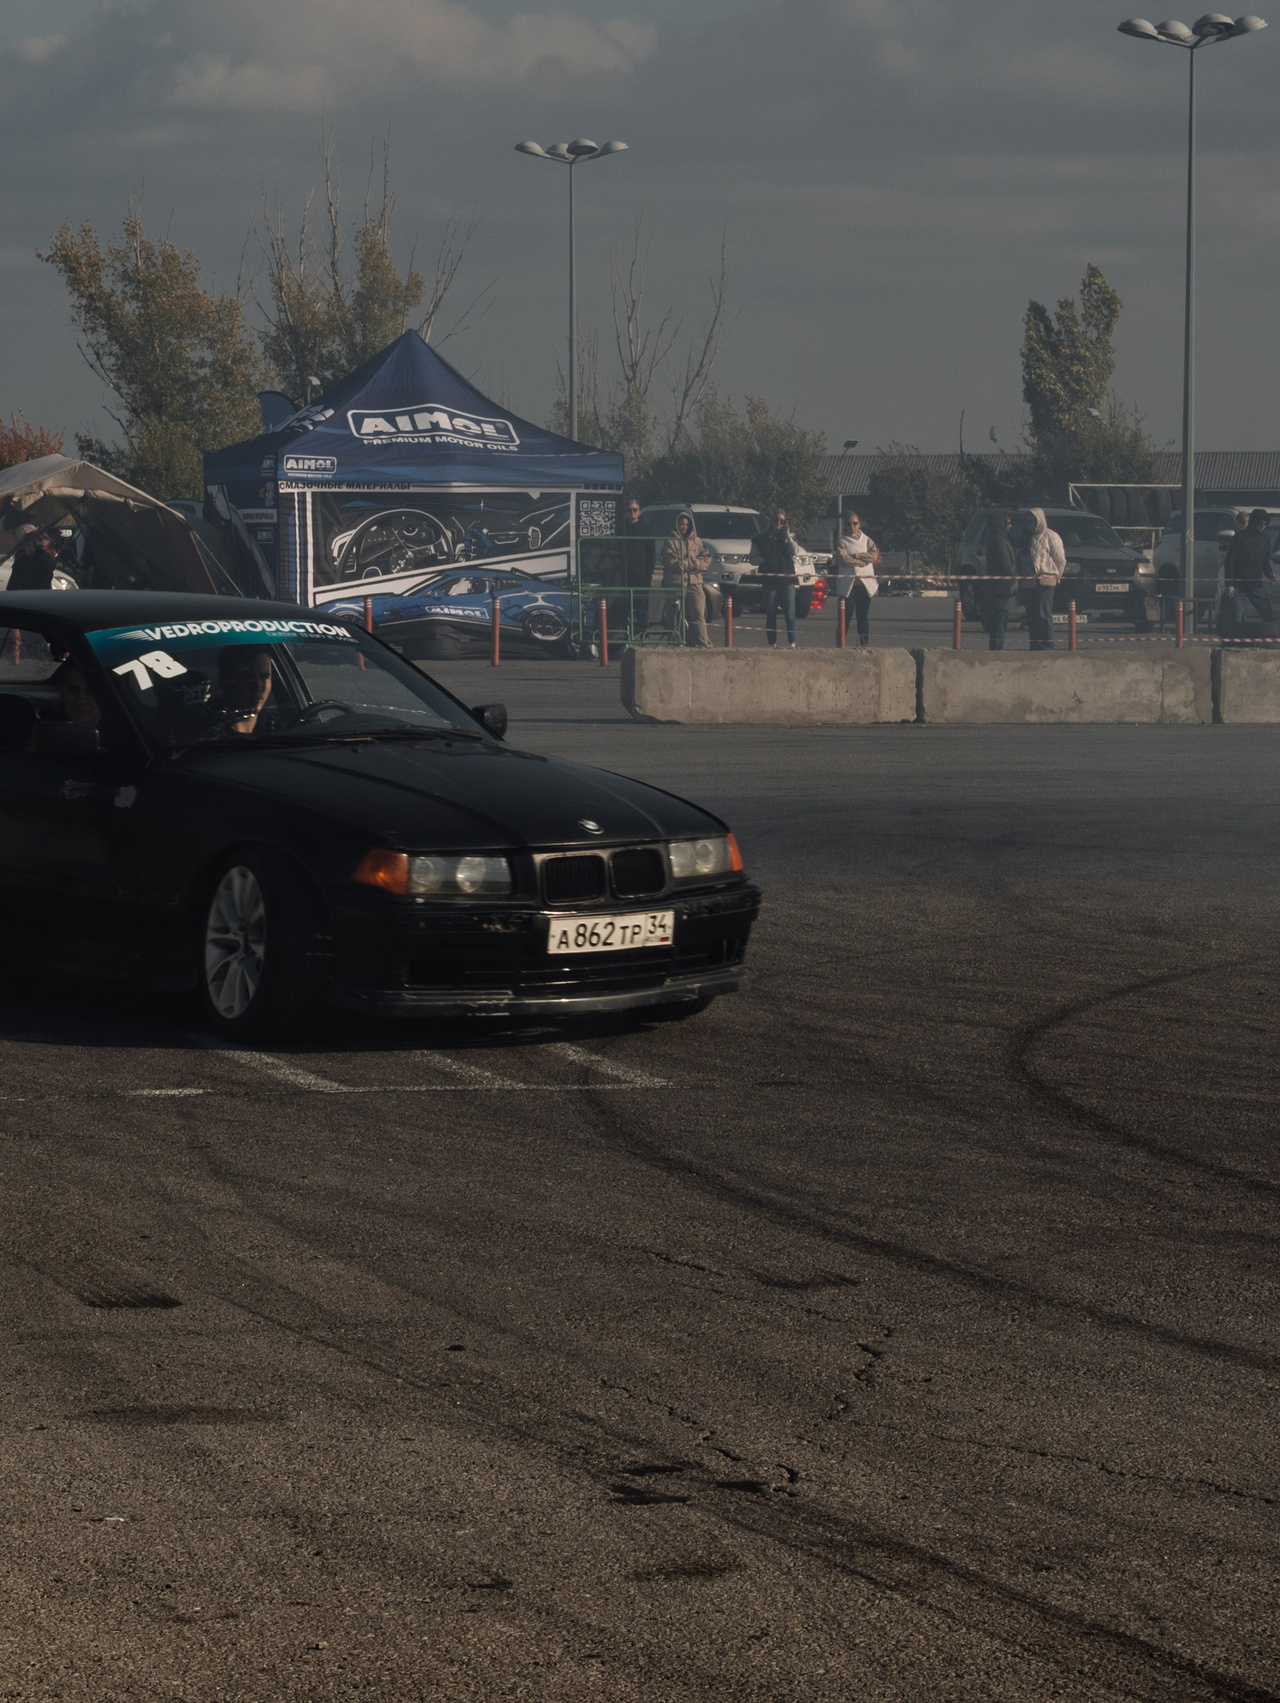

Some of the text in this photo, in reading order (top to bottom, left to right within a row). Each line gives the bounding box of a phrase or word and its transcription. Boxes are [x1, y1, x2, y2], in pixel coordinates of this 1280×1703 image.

[360, 411, 509, 438] AIMOL
[363, 436, 519, 452] PREMIUM MOTOR OILS
[286, 459, 334, 470] AIMOL
[279, 482, 411, 490] СМАЗОЧНЫЕ МАТЕРИАЛЫ
[431, 607, 484, 618] AIMOL
[147, 620, 352, 641] VEDROPRODUCTION
[112, 650, 188, 690] 78
[649, 914, 666, 934] 34
